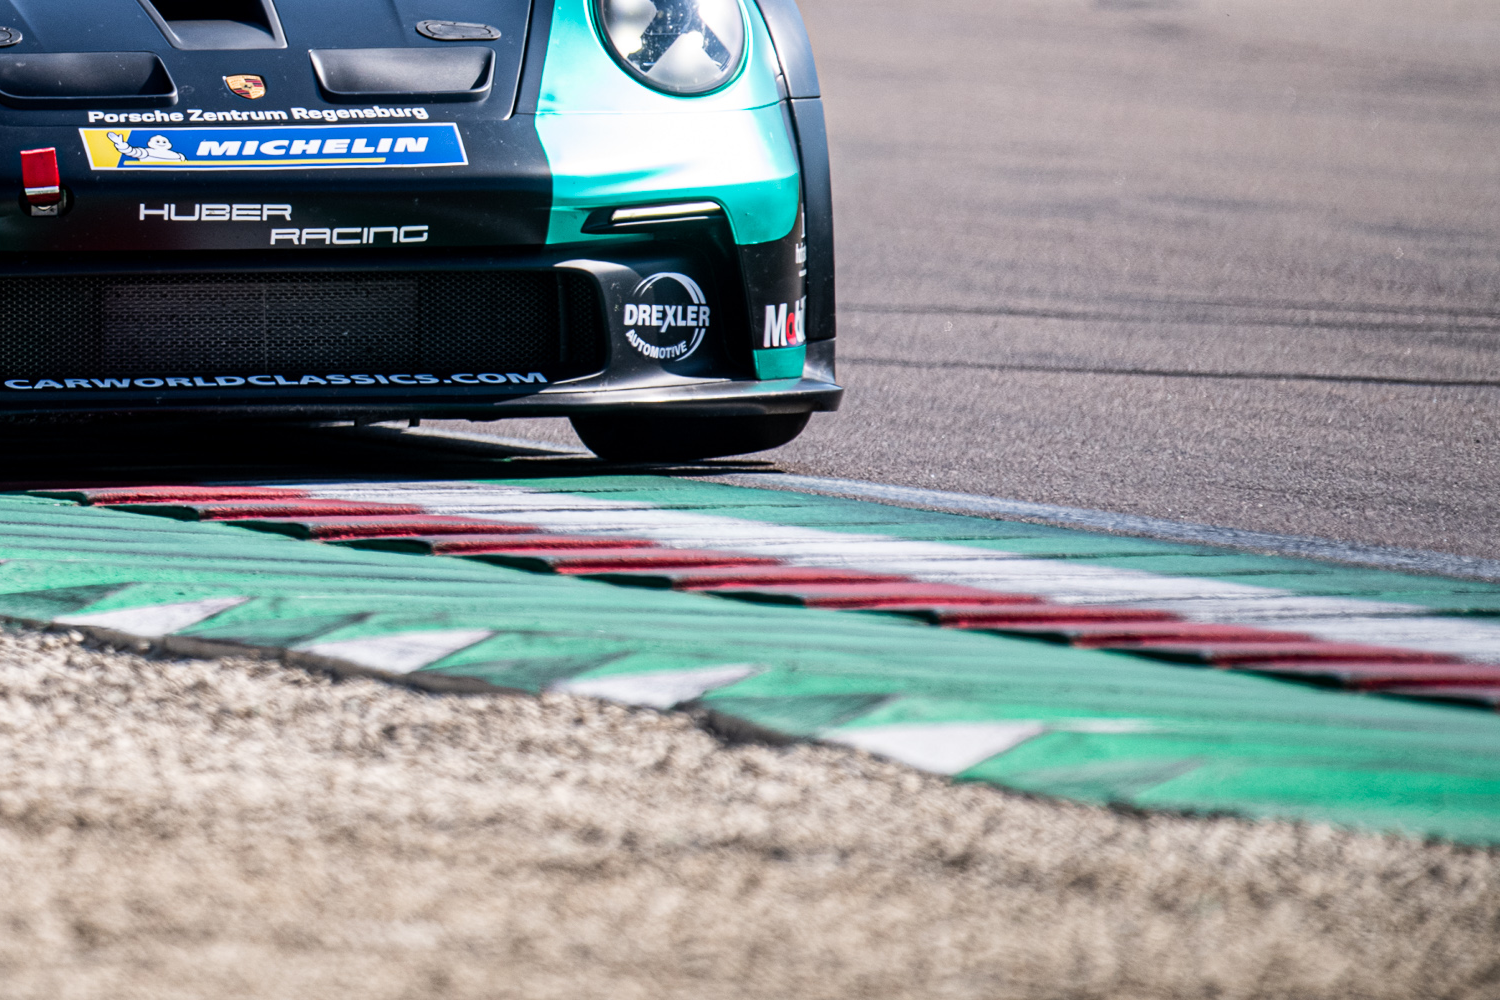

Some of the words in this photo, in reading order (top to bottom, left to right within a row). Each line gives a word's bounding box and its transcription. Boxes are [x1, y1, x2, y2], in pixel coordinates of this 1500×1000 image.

[88, 109, 184, 124] Porsche
[187, 107, 288, 123] Zentrum
[290, 106, 430, 122] Regensburg
[195, 136, 430, 157] MICHELIN
[138, 203, 293, 222] HUBER
[269, 225, 430, 246] RACING
[624, 303, 711, 333] DREXLER
[625, 328, 688, 359] AUTOMOTIVE
[3, 372, 548, 390] CARWORLDCLASSICS.COM
